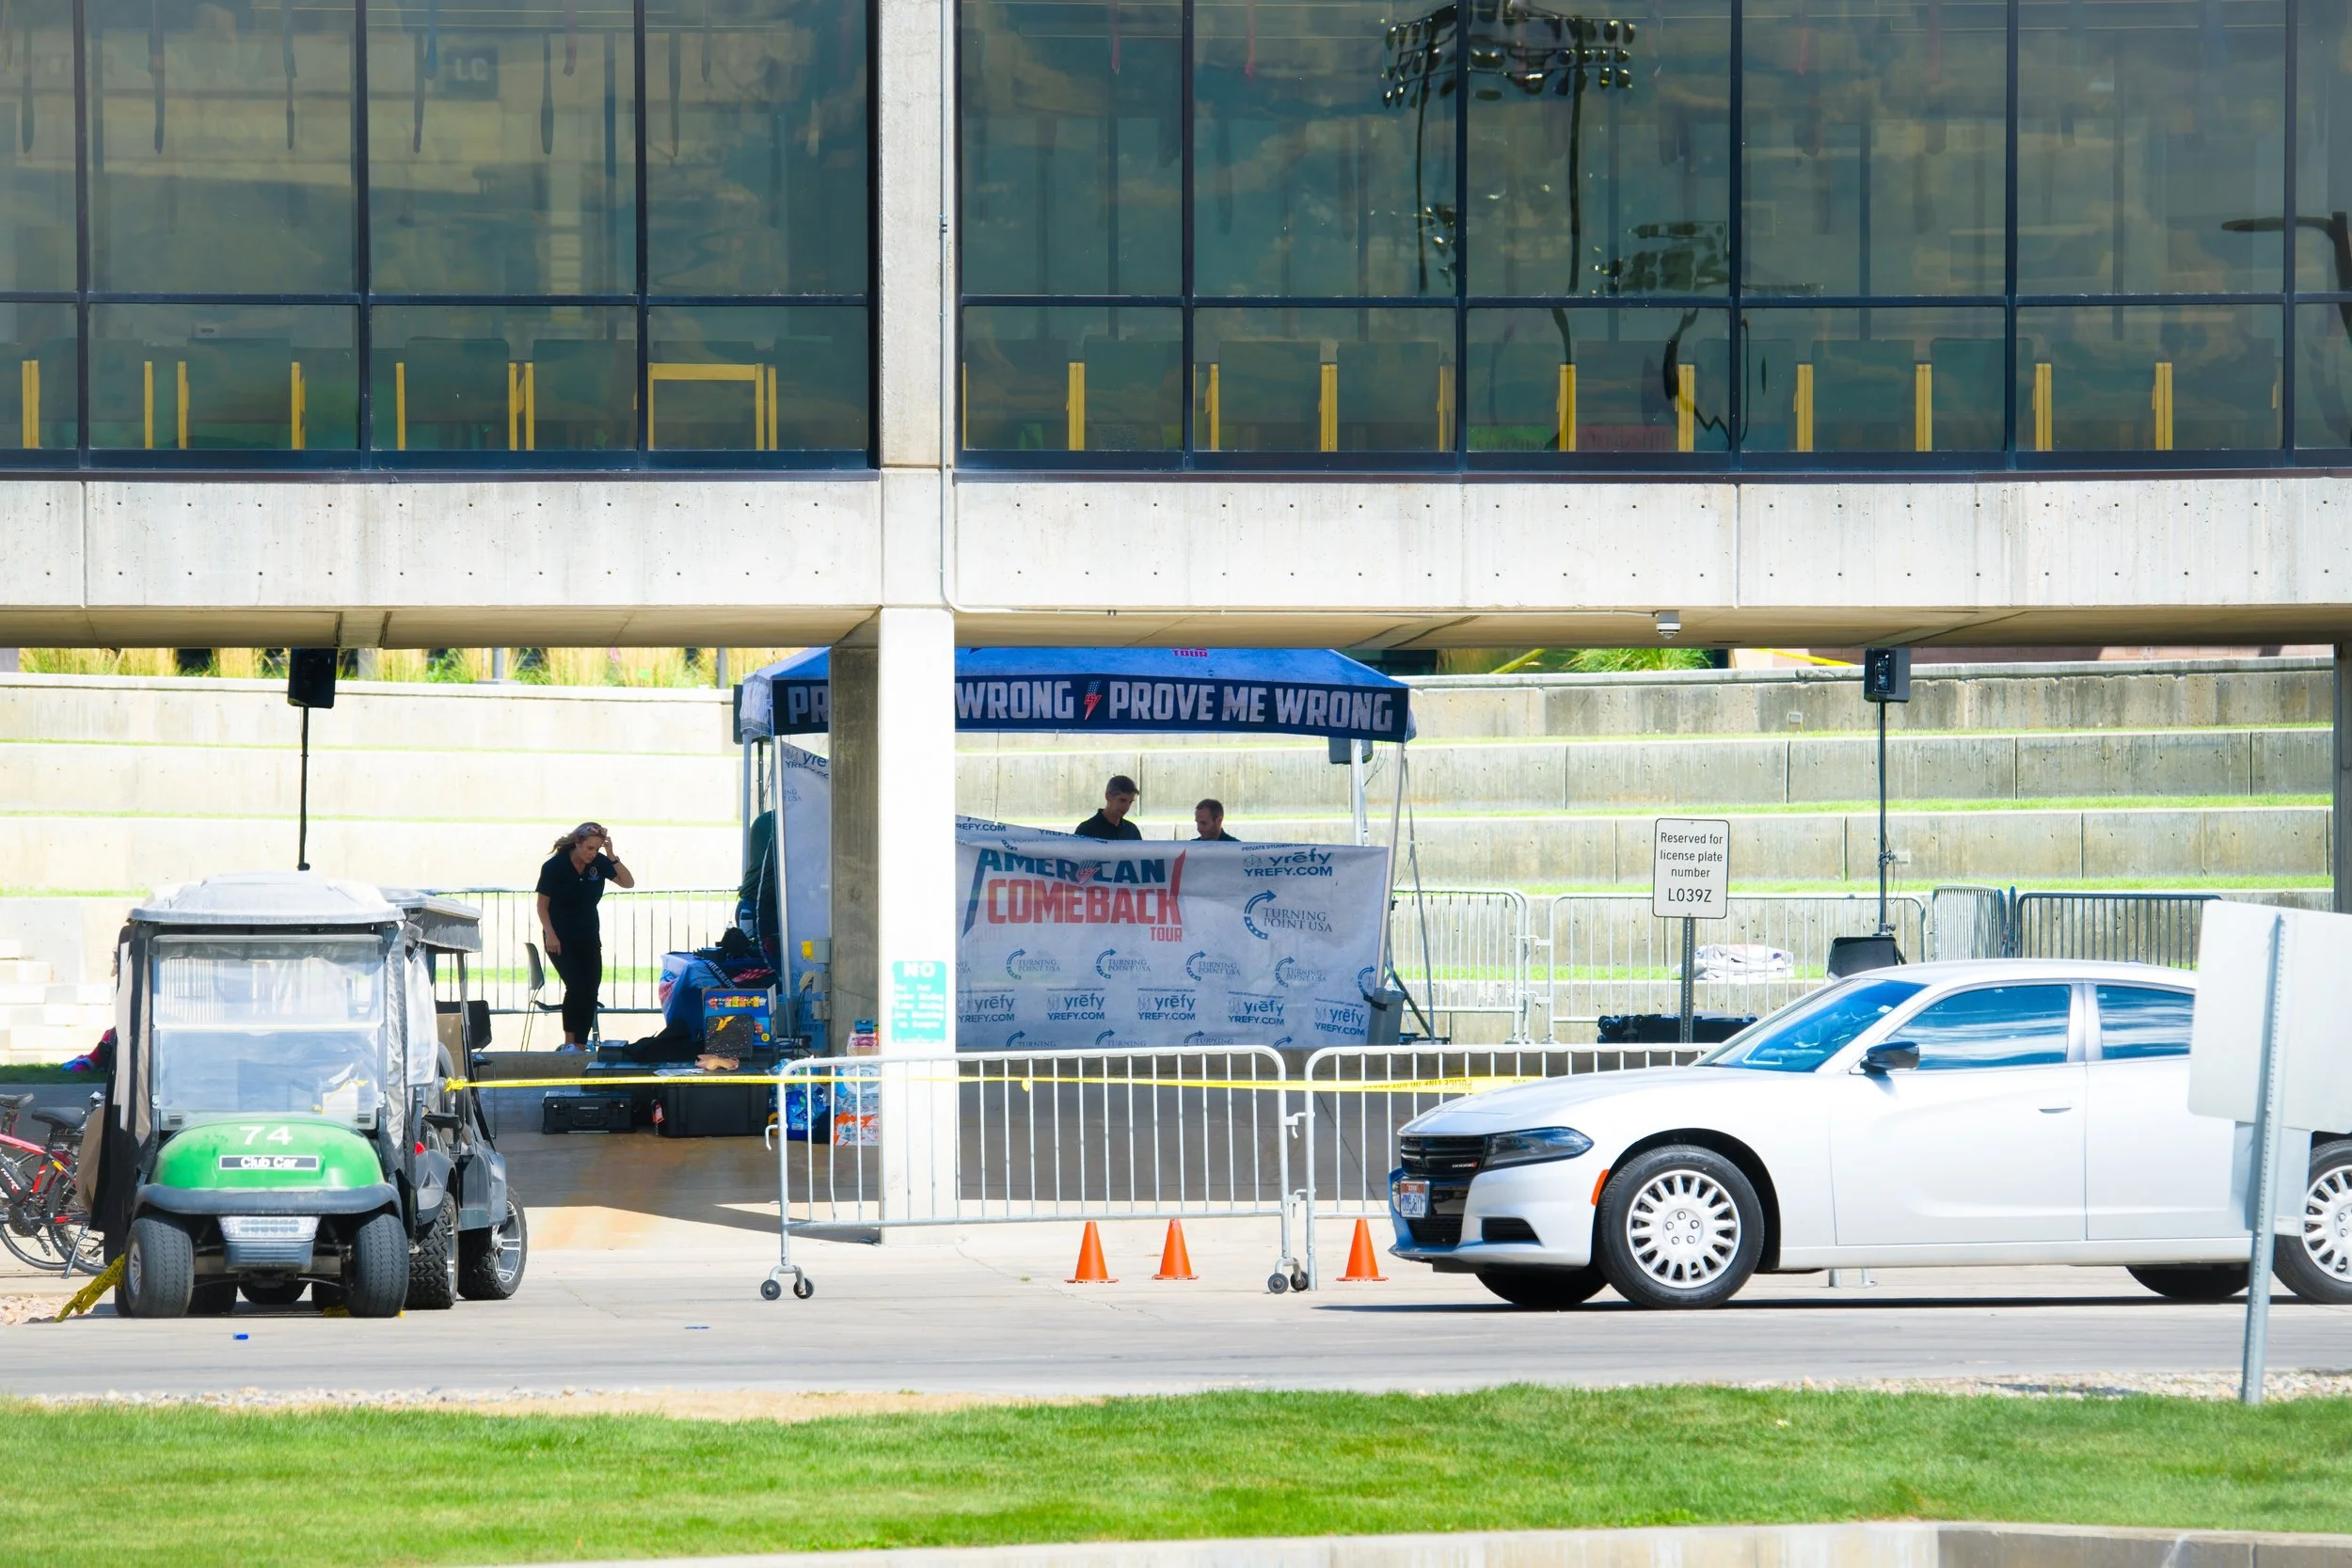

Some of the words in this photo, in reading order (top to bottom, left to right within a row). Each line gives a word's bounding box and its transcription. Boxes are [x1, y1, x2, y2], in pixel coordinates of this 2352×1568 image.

[787, 686, 828, 724] PR
[955, 681, 1074, 719] WRONG
[1109, 681, 1215, 721] PROVE
[1222, 687, 1267, 722] ME
[1275, 688, 1392, 732] WRONG
[956, 823, 1006, 832] REFY.COM
[1661, 832, 1706, 844] Reserved
[1709, 834, 1724, 844] for
[1661, 850, 1695, 861] license
[1697, 851, 1723, 863] plate
[1244, 866, 1332, 877] YREFY.COM
[1671, 867, 1710, 878] number
[988, 879, 1183, 926] COMEBACK
[1263, 907, 1327, 922] TURNING
[1263, 918, 1305, 929] POINT
[1308, 921, 1332, 932] USA
[1150, 927, 1183, 942] TOUR
[903, 962, 935, 977] NO
[959, 1014, 1015, 1022] YREFY.COM
[1047, 1011, 1104, 1021] YREFY.COM
[1138, 1012, 1196, 1021] YREFY.COM
[1228, 1016, 1284, 1025] YREFY.COM
[1315, 1022, 1365, 1036] YREFY.COM
[239, 1126, 293, 1146] 74
[240, 1156, 271, 1168] Club
[273, 1157, 297, 1168] Car
